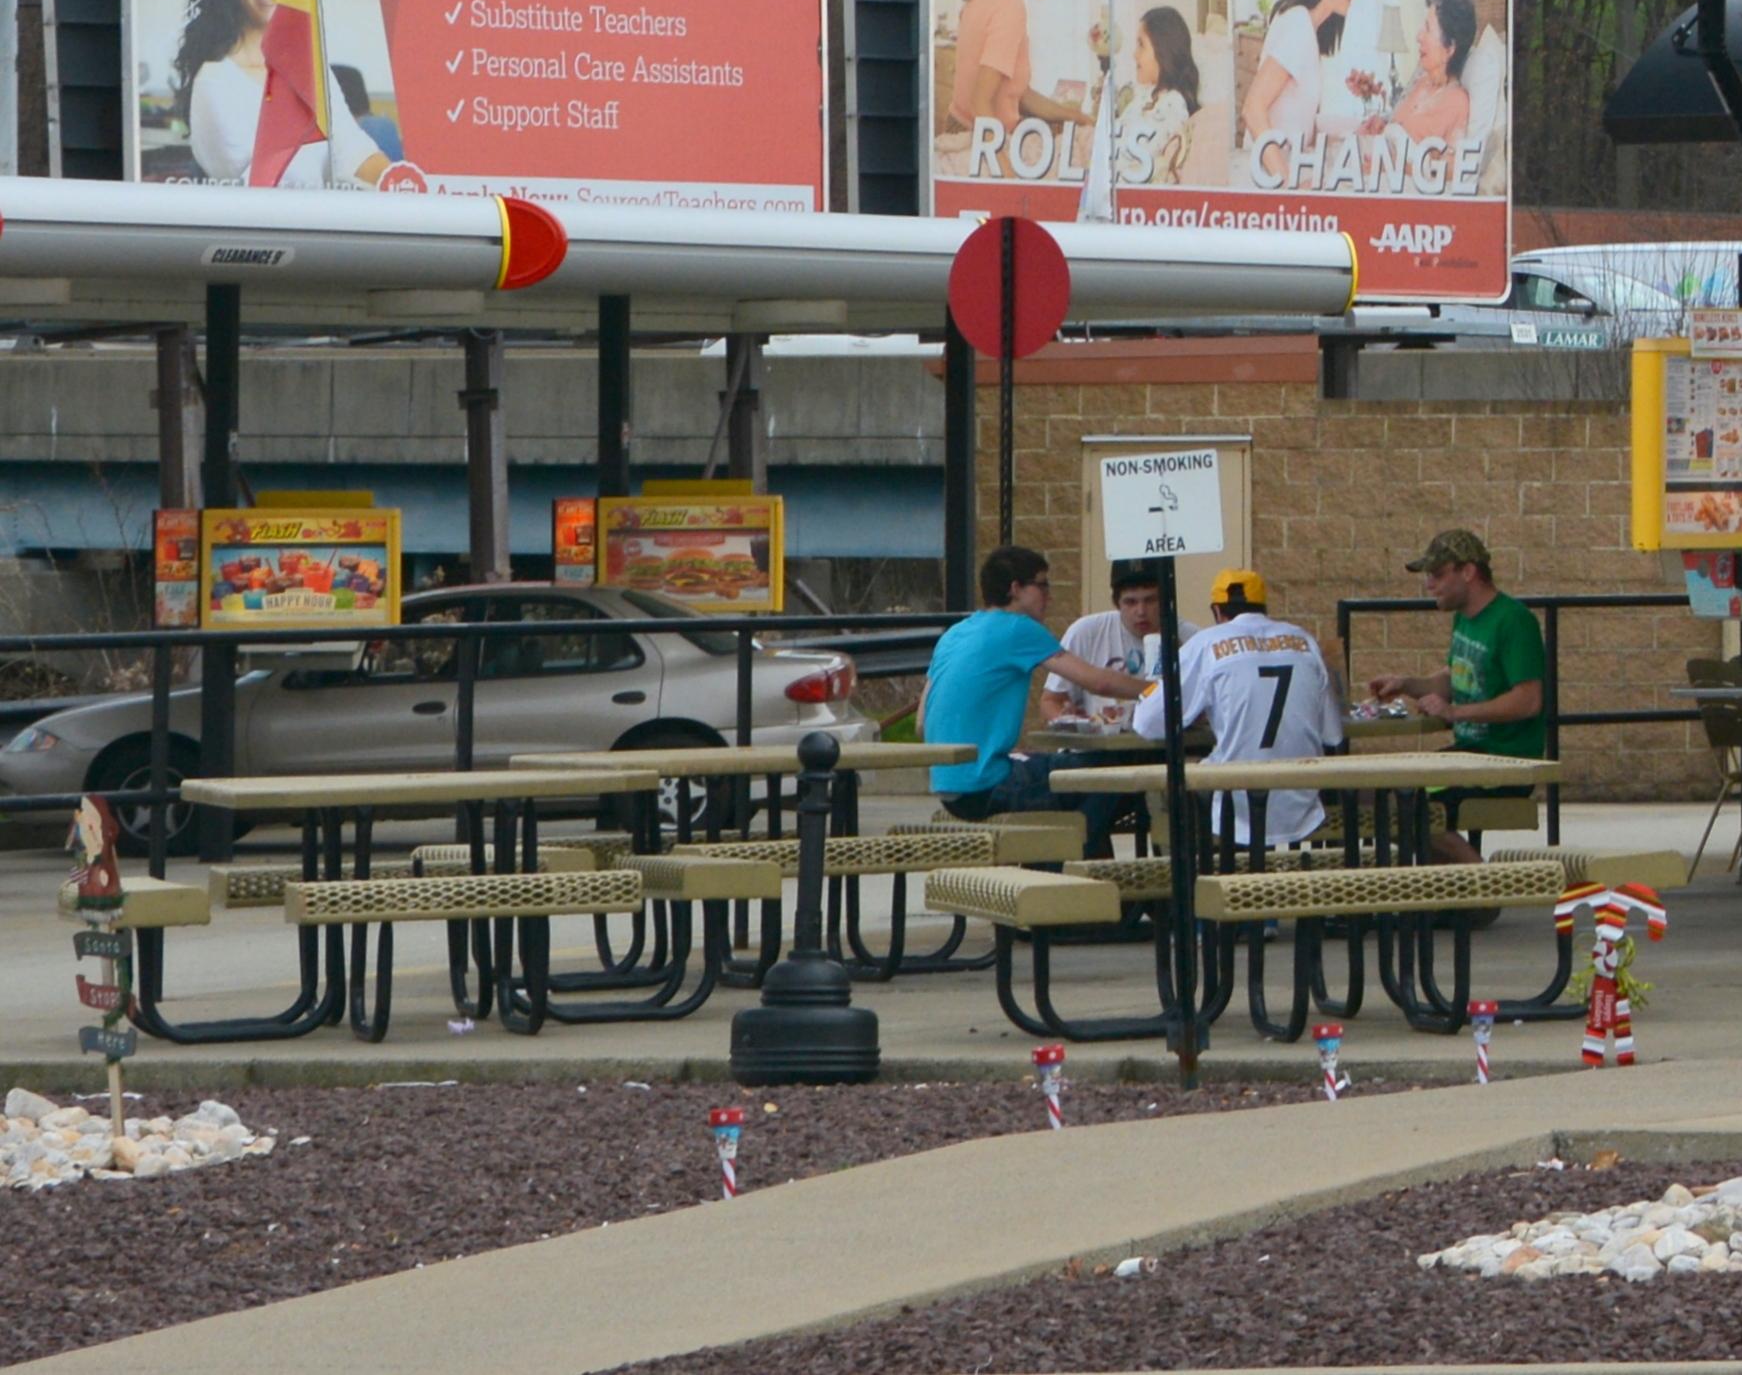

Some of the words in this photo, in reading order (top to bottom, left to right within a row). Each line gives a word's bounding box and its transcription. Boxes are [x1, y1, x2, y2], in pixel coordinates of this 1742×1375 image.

[471, 0, 583, 32] Substitute
[590, 5, 687, 37] Teachers
[471, 48, 567, 80] Personal
[574, 51, 625, 83] Care
[632, 55, 744, 87] Assistants
[472, 96, 560, 132] Support
[567, 100, 620, 129] Staff
[969, 115, 1157, 184] ROLS
[1250, 124, 1485, 197] CHANGE
[1369, 223, 1453, 254] AARP
[211, 249, 271, 265] CLEARANCE
[1546, 331, 1599, 348] LAMAR
[1106, 453, 1214, 476] NON-SMOKING
[251, 521, 303, 540] FLASH
[1144, 535, 1187, 554] AREA
[266, 594, 302, 609] HAPPY
[303, 594, 334, 609] HOUR
[1257, 664, 1294, 749] 7
[85, 937, 120, 953] Santa
[97, 1031, 126, 1049] Here
